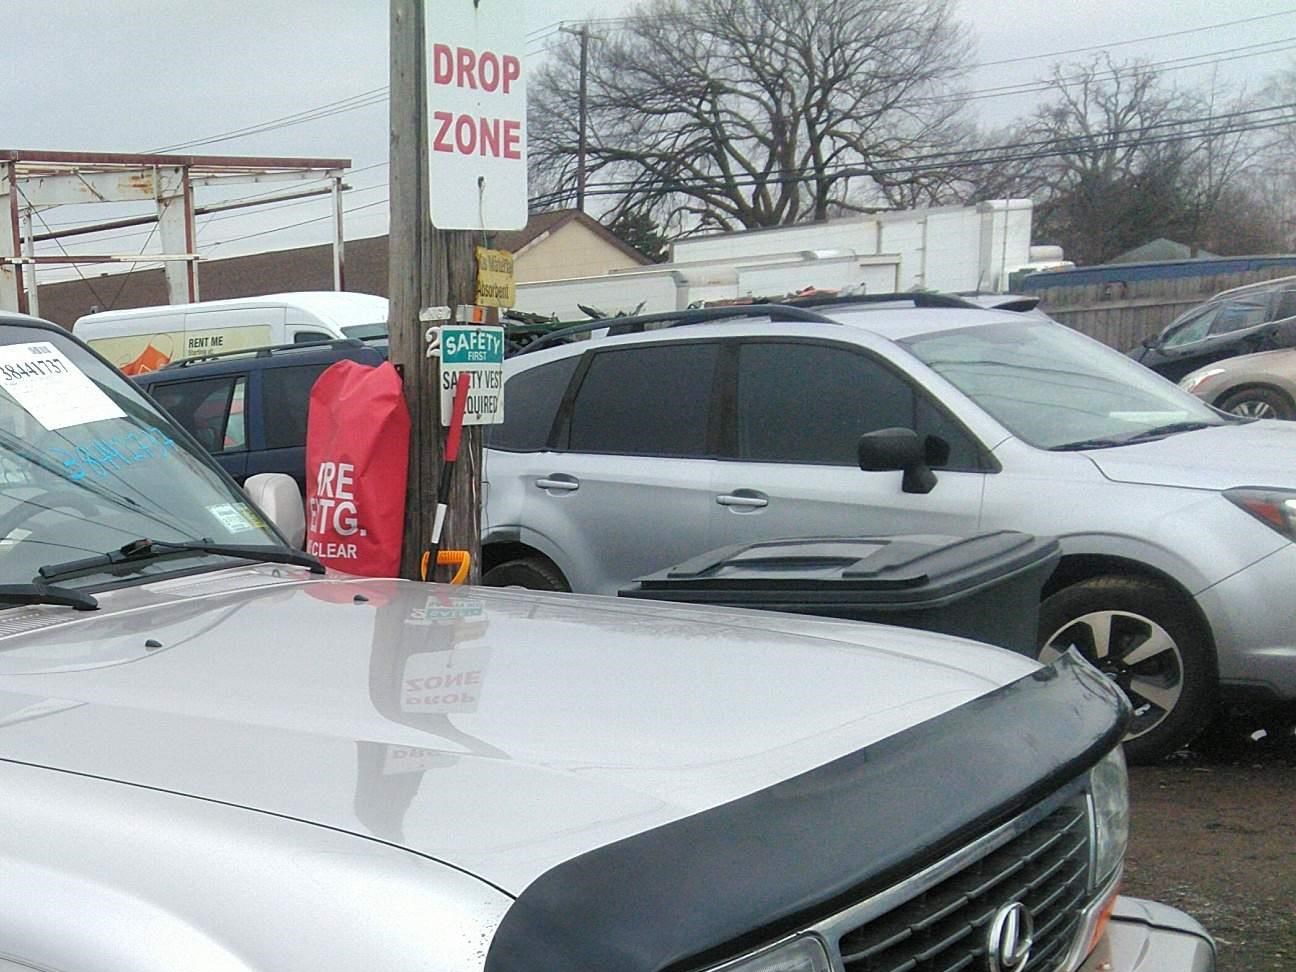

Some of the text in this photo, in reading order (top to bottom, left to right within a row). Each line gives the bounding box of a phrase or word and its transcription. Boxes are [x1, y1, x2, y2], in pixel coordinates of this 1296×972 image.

[432, 43, 521, 95] DROP
[432, 110, 521, 160] ZONE
[188, 335, 224, 348] RENT ME
[446, 331, 501, 356] SAFETY
[467, 351, 487, 361] FIRST
[442, 370, 503, 390] SATY VEST
[452, 395, 498, 414] QUIRED
